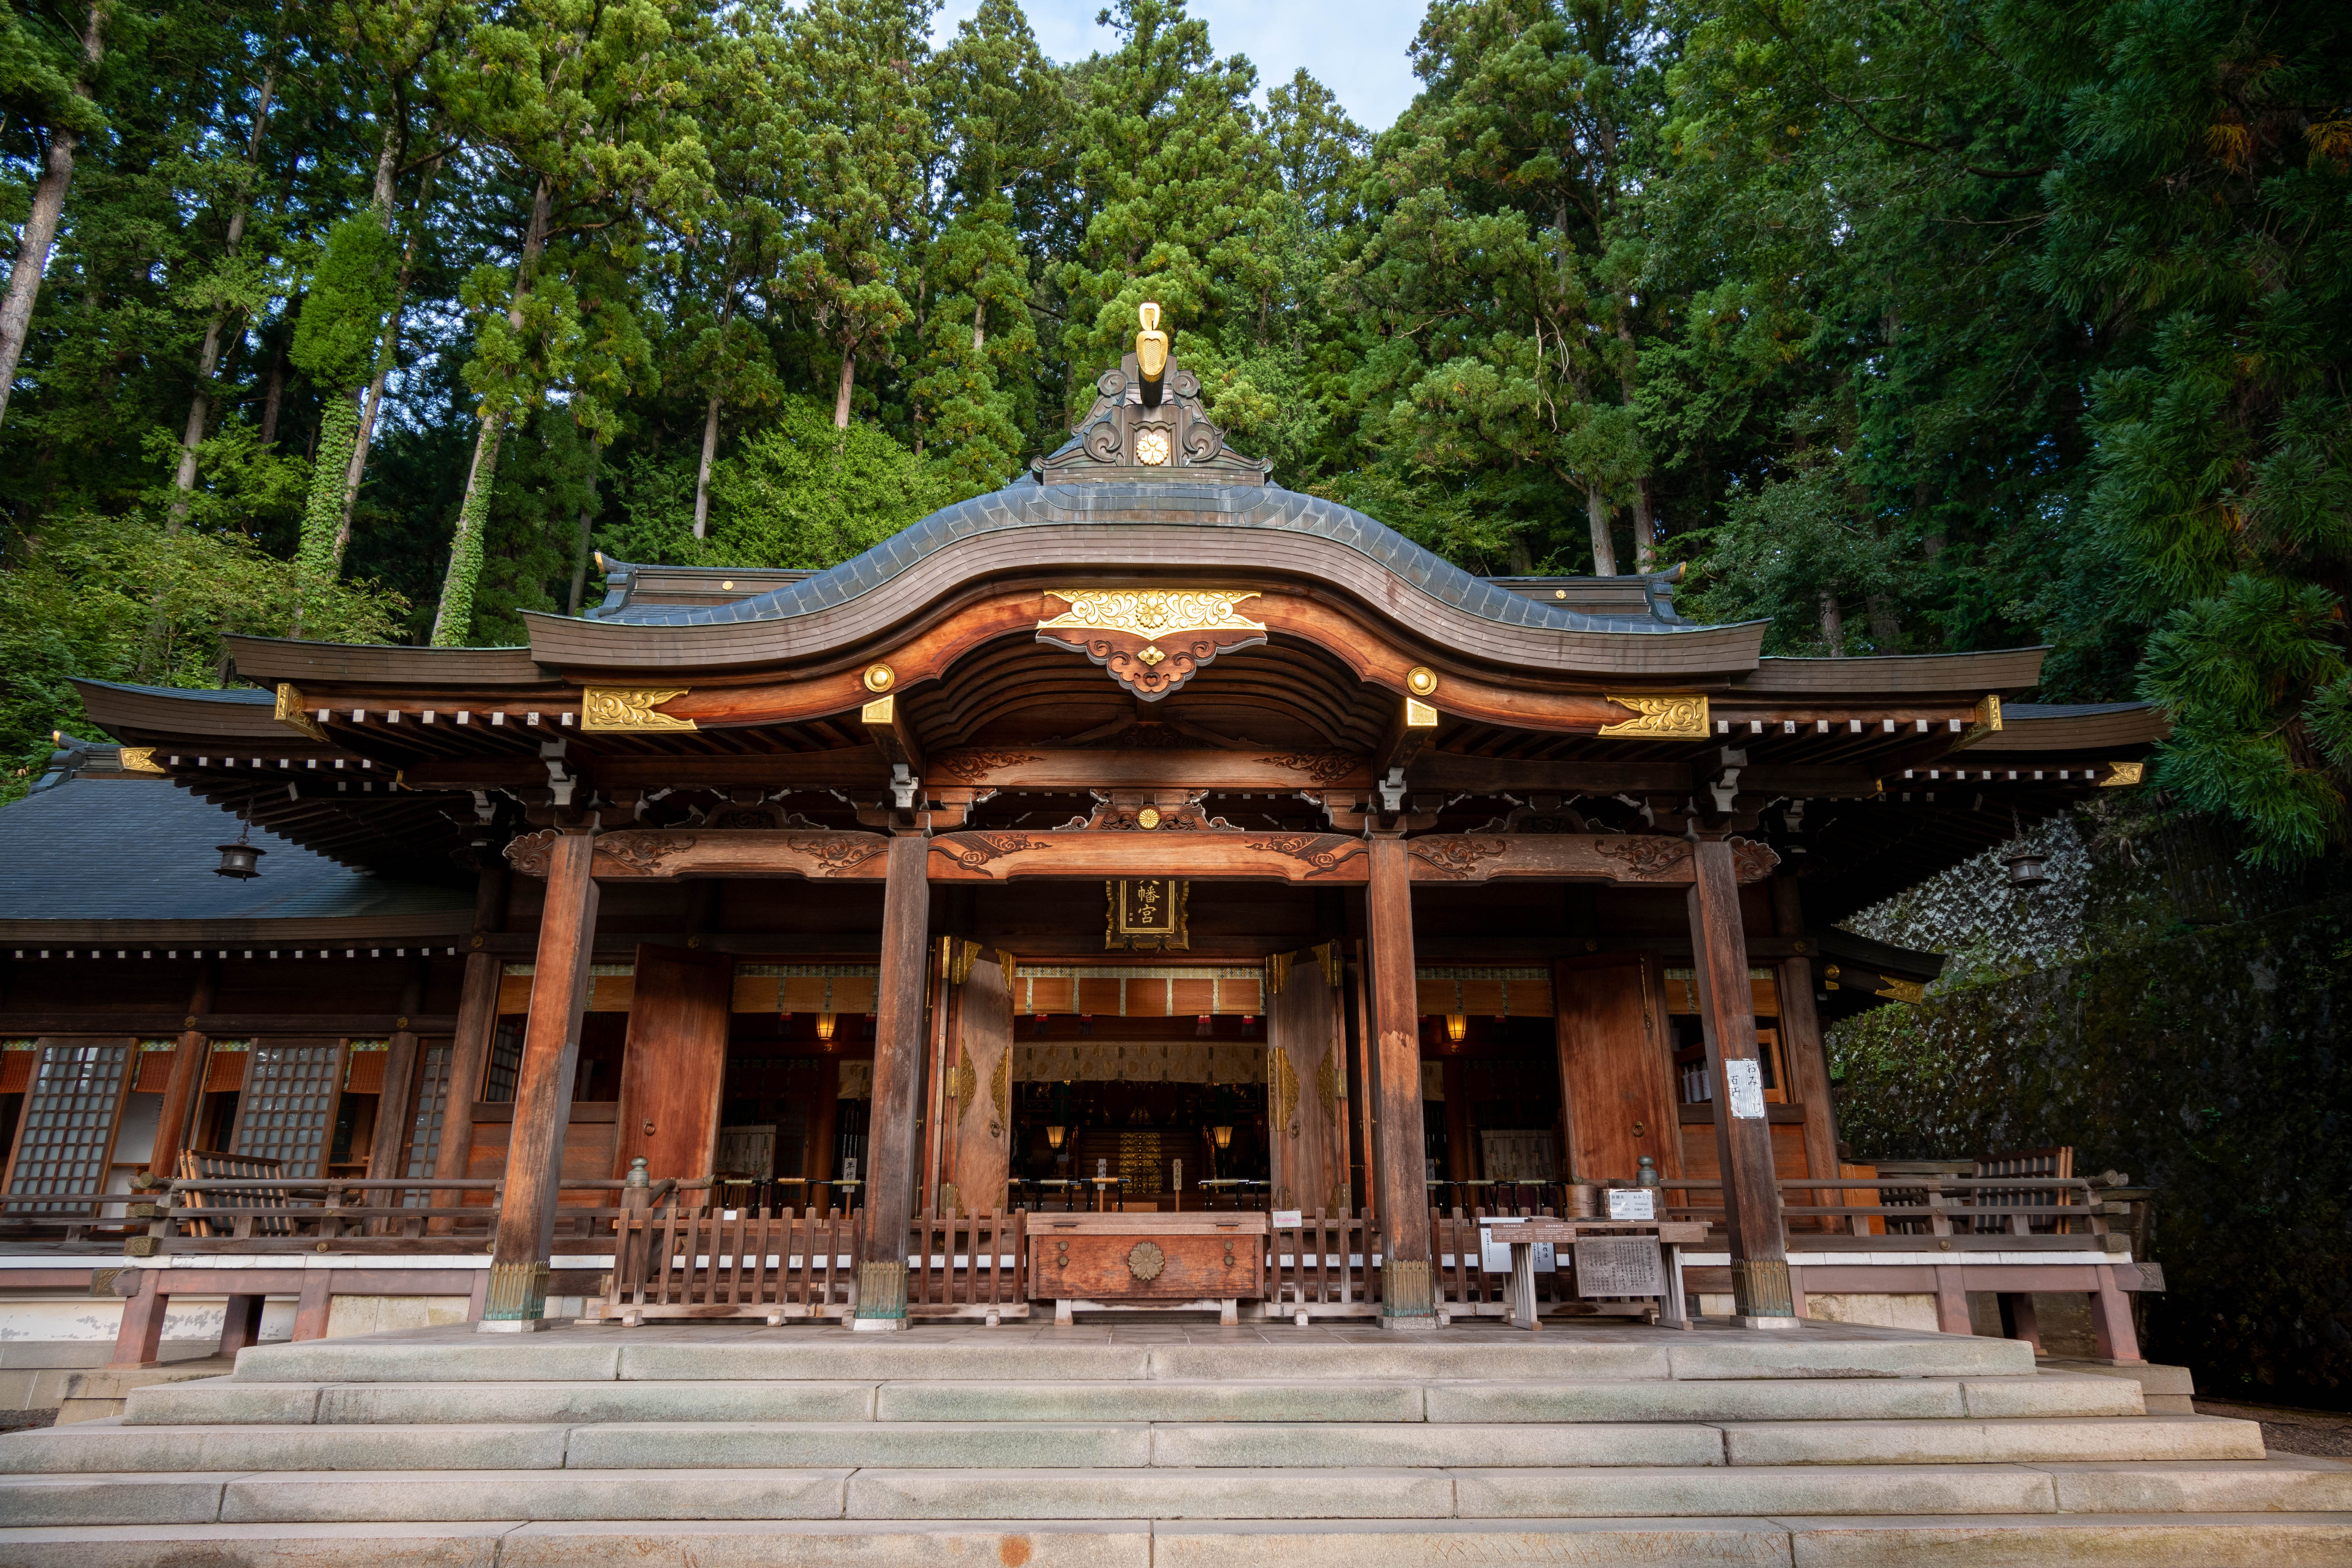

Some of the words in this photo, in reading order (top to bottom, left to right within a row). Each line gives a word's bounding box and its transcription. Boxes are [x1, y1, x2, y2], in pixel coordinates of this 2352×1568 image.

[1730, 1076, 1740, 1097] 百円
[1747, 1063, 1760, 1113] おみくじ
[846, 1162, 855, 1188] 年行
